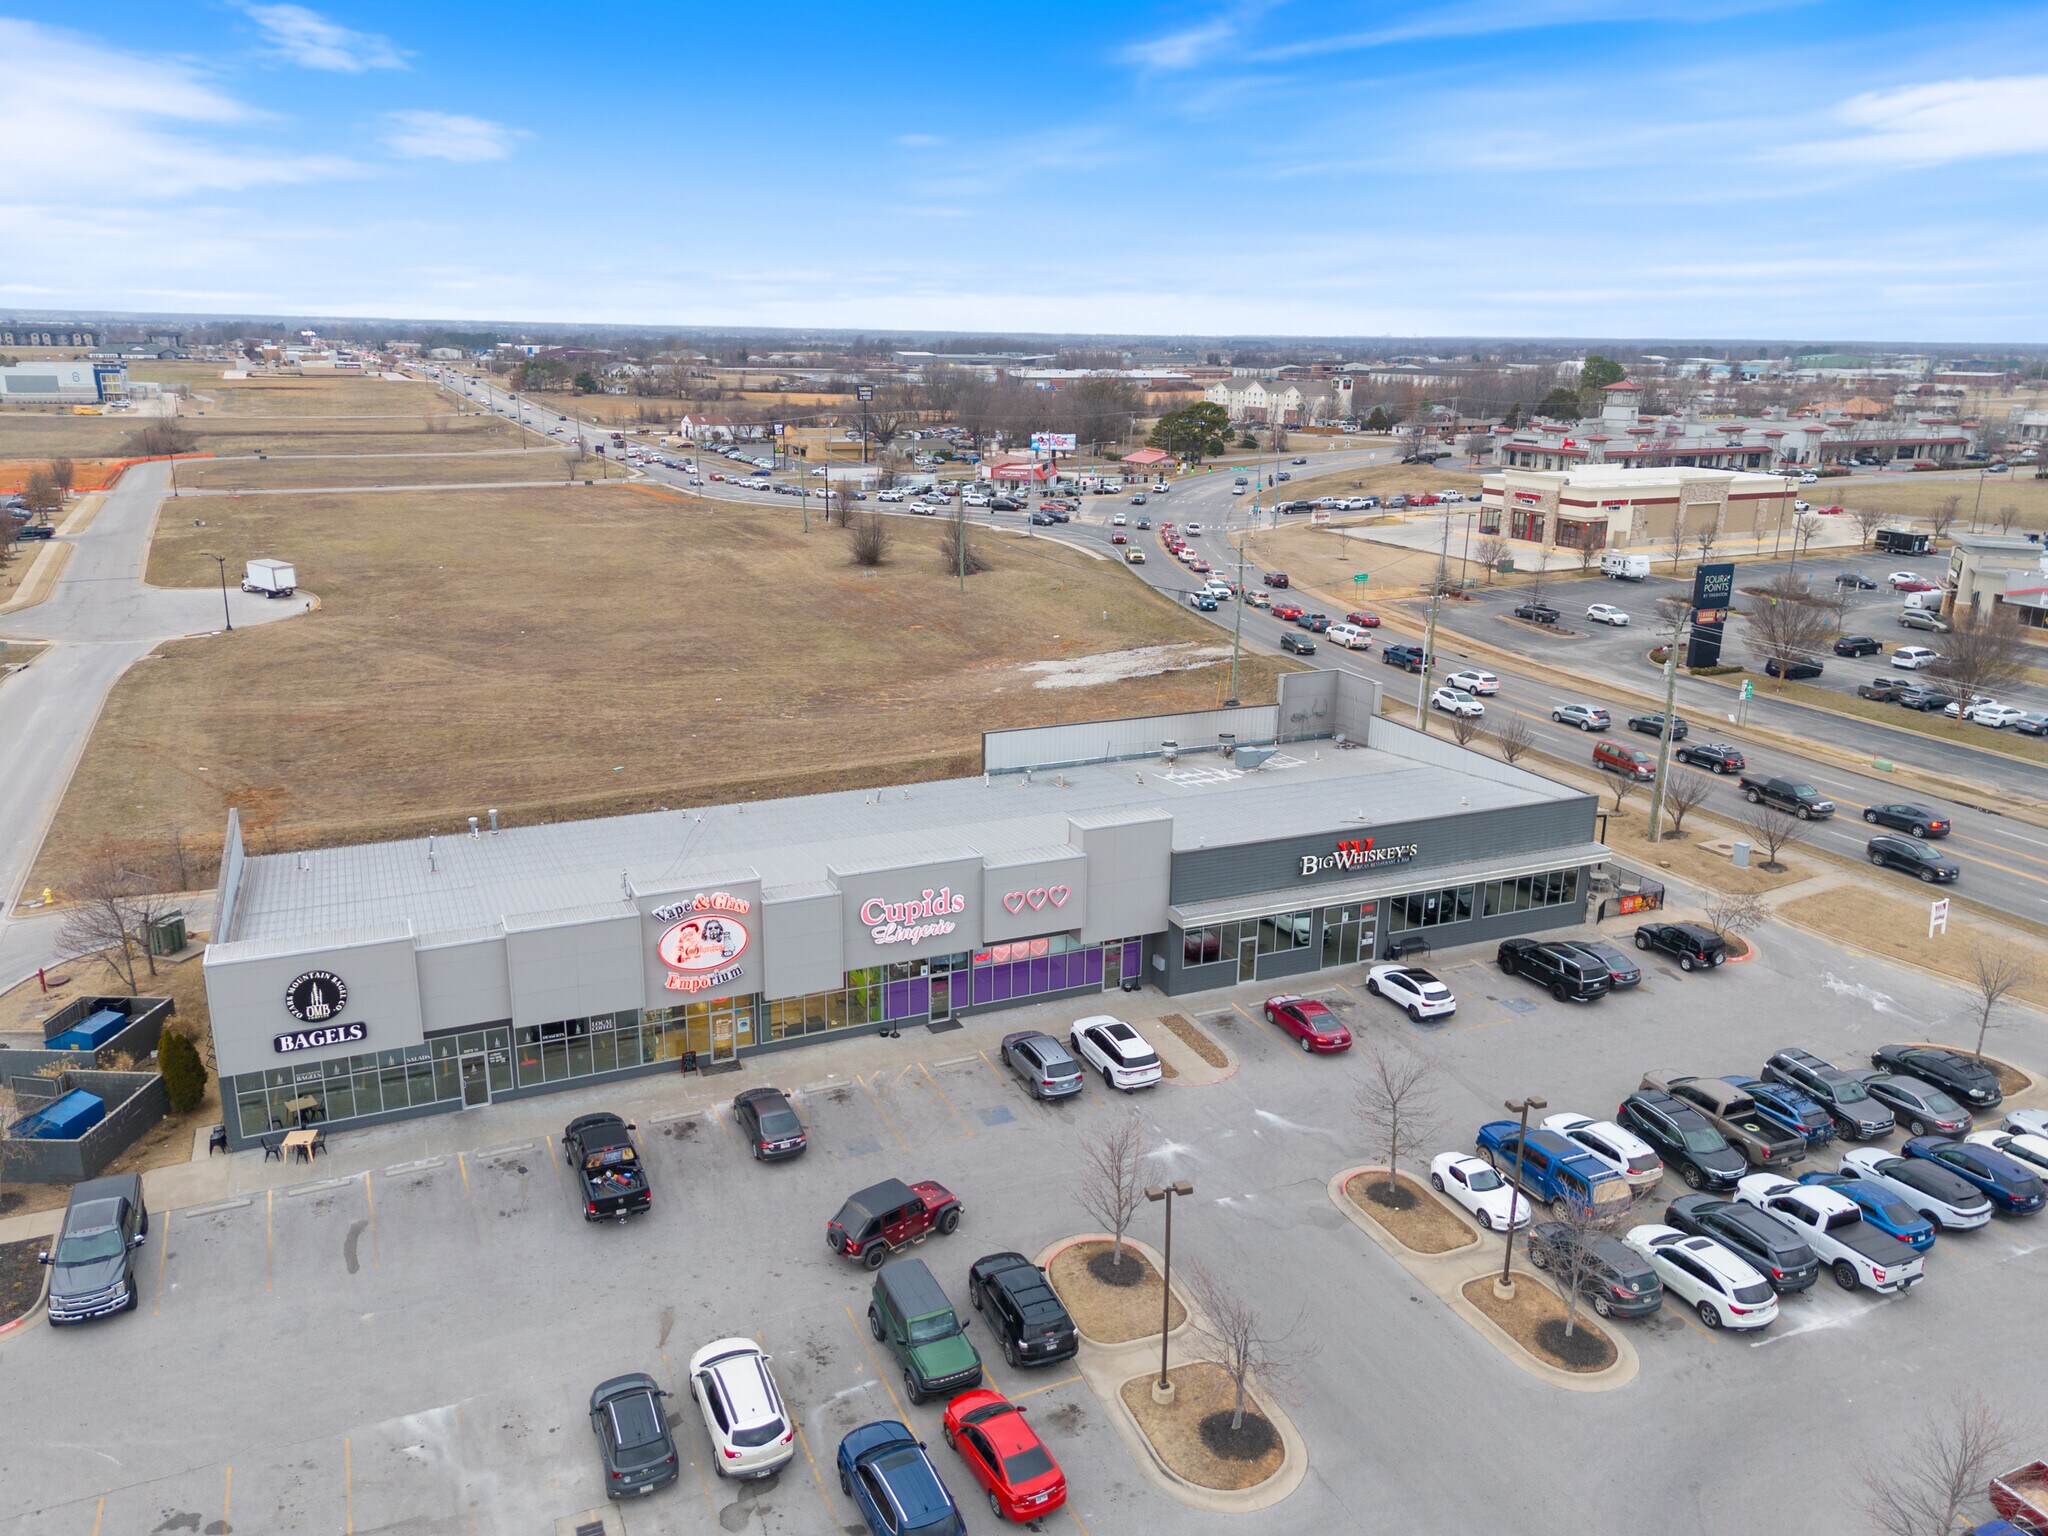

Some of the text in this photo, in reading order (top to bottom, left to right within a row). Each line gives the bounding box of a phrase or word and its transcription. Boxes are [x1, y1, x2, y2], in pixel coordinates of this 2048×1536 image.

[1704, 583, 1729, 592] POINTS
[1705, 575, 1725, 583] FOUR
[653, 892, 750, 923] Vape & Glass
[860, 886, 965, 925] Cupids
[871, 919, 956, 945] Lingerie
[288, 972, 331, 994] MOUNTAIN
[331, 976, 347, 999] BAGEL
[666, 964, 743, 993] Emporium
[286, 995, 303, 1019] OZARK
[306, 1003, 331, 1017] OMB
[592, 1019, 612, 1027] LOCAL
[279, 1024, 364, 1052] BAGELS
[542, 1032, 565, 1040] DESSERTS
[406, 1054, 431, 1063] SALADS
[296, 1072, 322, 1082] BAGELS
